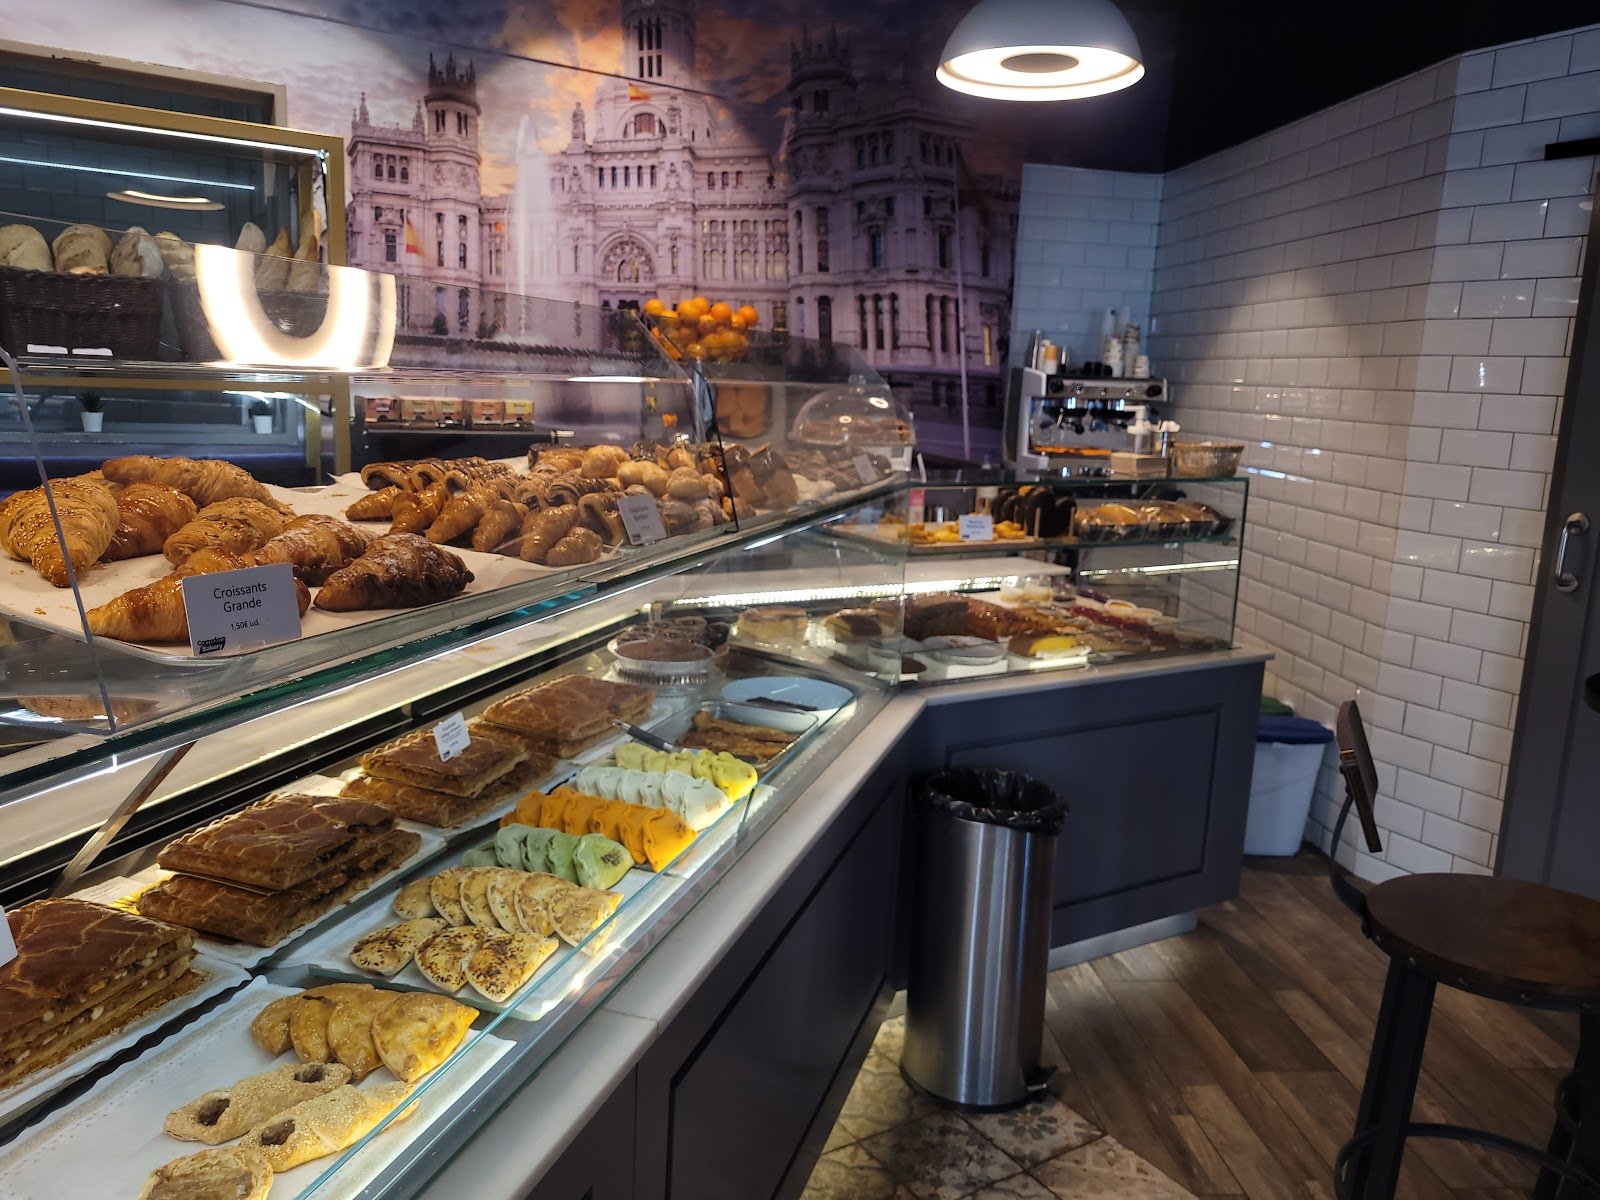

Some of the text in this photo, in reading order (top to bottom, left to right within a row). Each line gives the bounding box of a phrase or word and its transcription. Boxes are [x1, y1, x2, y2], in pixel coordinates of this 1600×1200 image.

[213, 582, 267, 599] Croissants
[223, 597, 262, 612] Grande
[230, 619, 261, 631] 1,50€ ud.
[201, 643, 224, 653] Bakery
